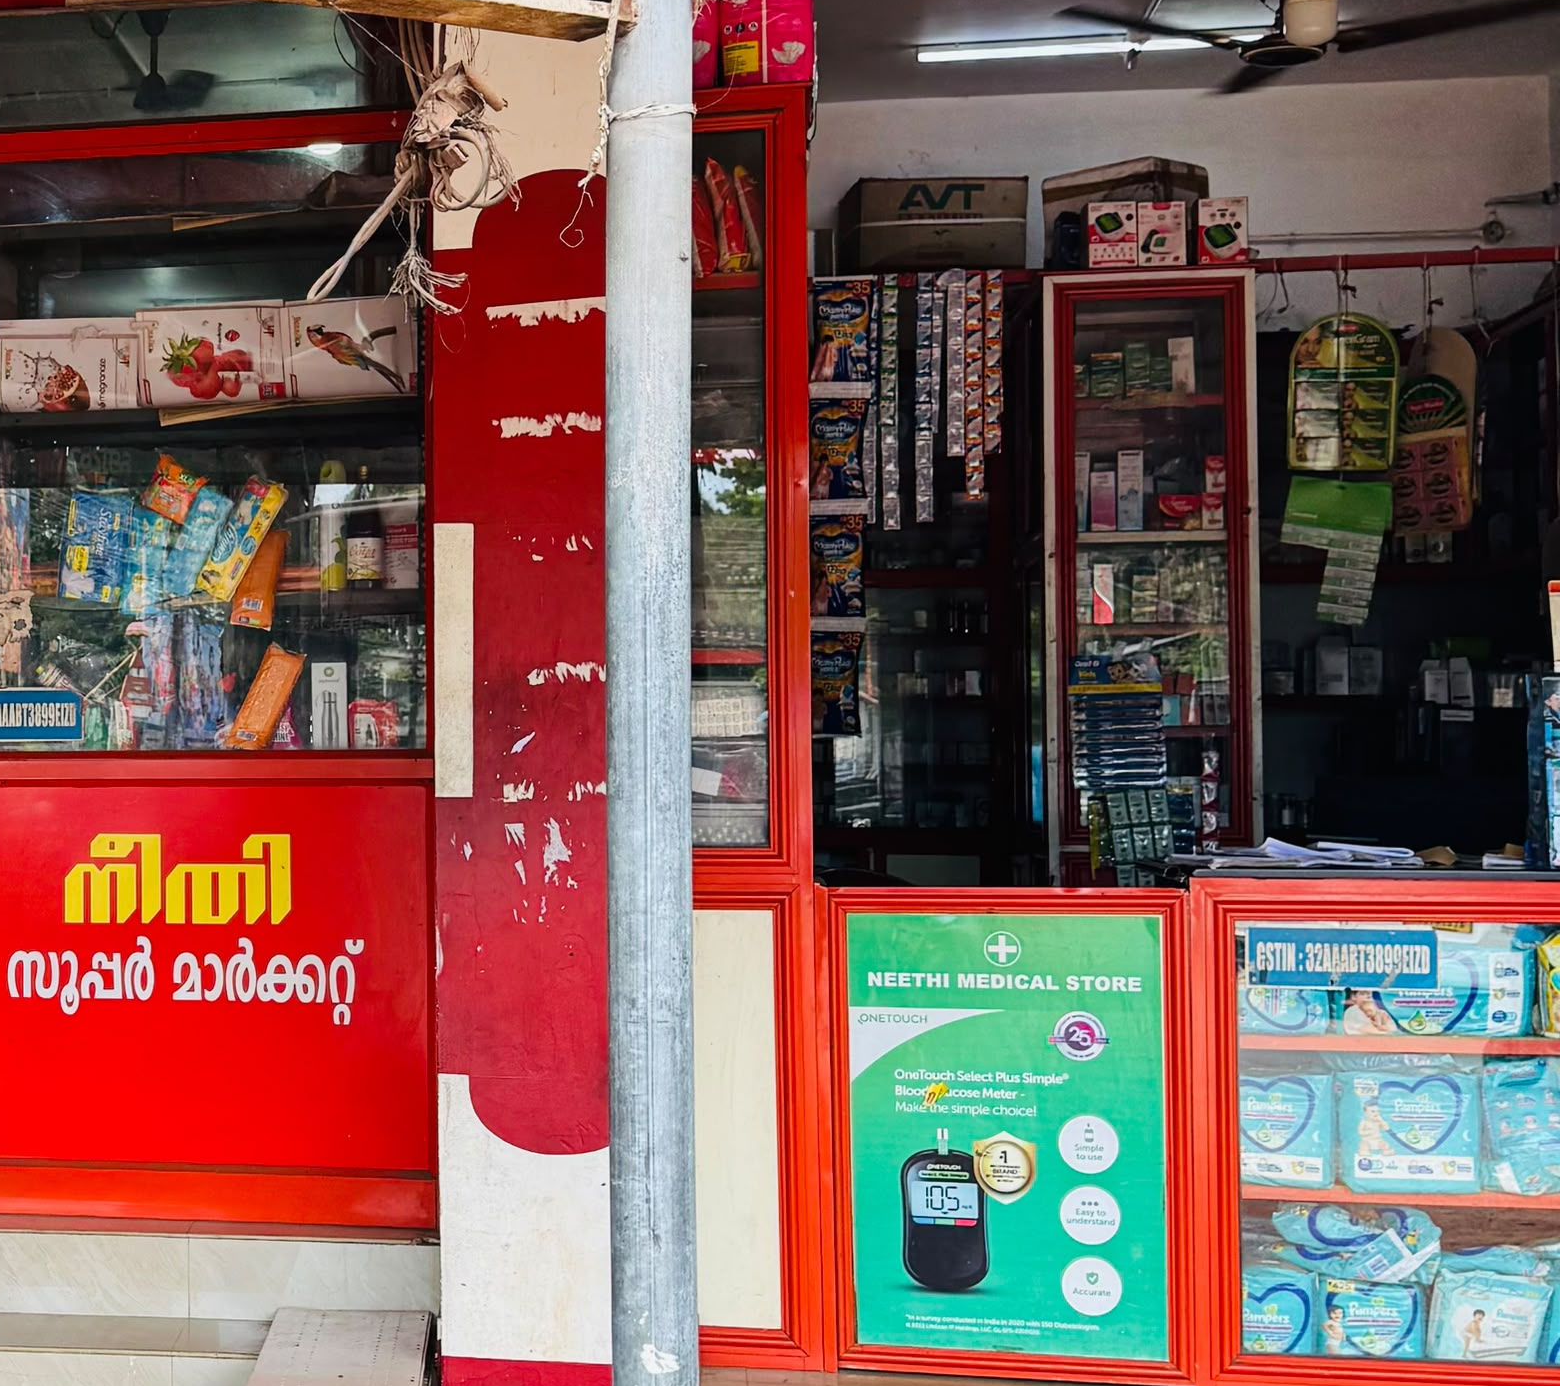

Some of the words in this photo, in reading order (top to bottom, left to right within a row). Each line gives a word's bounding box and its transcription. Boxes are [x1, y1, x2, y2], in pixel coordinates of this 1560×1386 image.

[899, 184, 985, 210] AVT
[64, 833, 293, 926] നീതി
[1256, 941, 1295, 972] GSTIN
[7, 935, 155, 1016] സൂപ്പർ
[172, 937, 366, 1026] മാർക്കറ്റ്
[867, 972, 950, 988] NEETHI
[957, 973, 1059, 990] MEDICAL
[1065, 976, 1142, 992] STORE
[858, 1013, 928, 1024] ONETOUCH
[1068, 1026, 1092, 1046] 25
[894, 1069, 955, 1081] OneTouch
[957, 1070, 993, 1082] Select
[995, 1071, 1020, 1083] Plus
[982, 1085, 1017, 1099] Meter
[951, 1104, 989, 1117] simple
[992, 1105, 1036, 1117] choice!
[1074, 1143, 1104, 1153] Simple
[1076, 1153, 1086, 1161] to
[925, 1185, 960, 1211] 105
[1075, 1208, 1095, 1217] Easy
[1066, 1217, 1116, 1226] understand
[1072, 1287, 1111, 1297] Accurate
